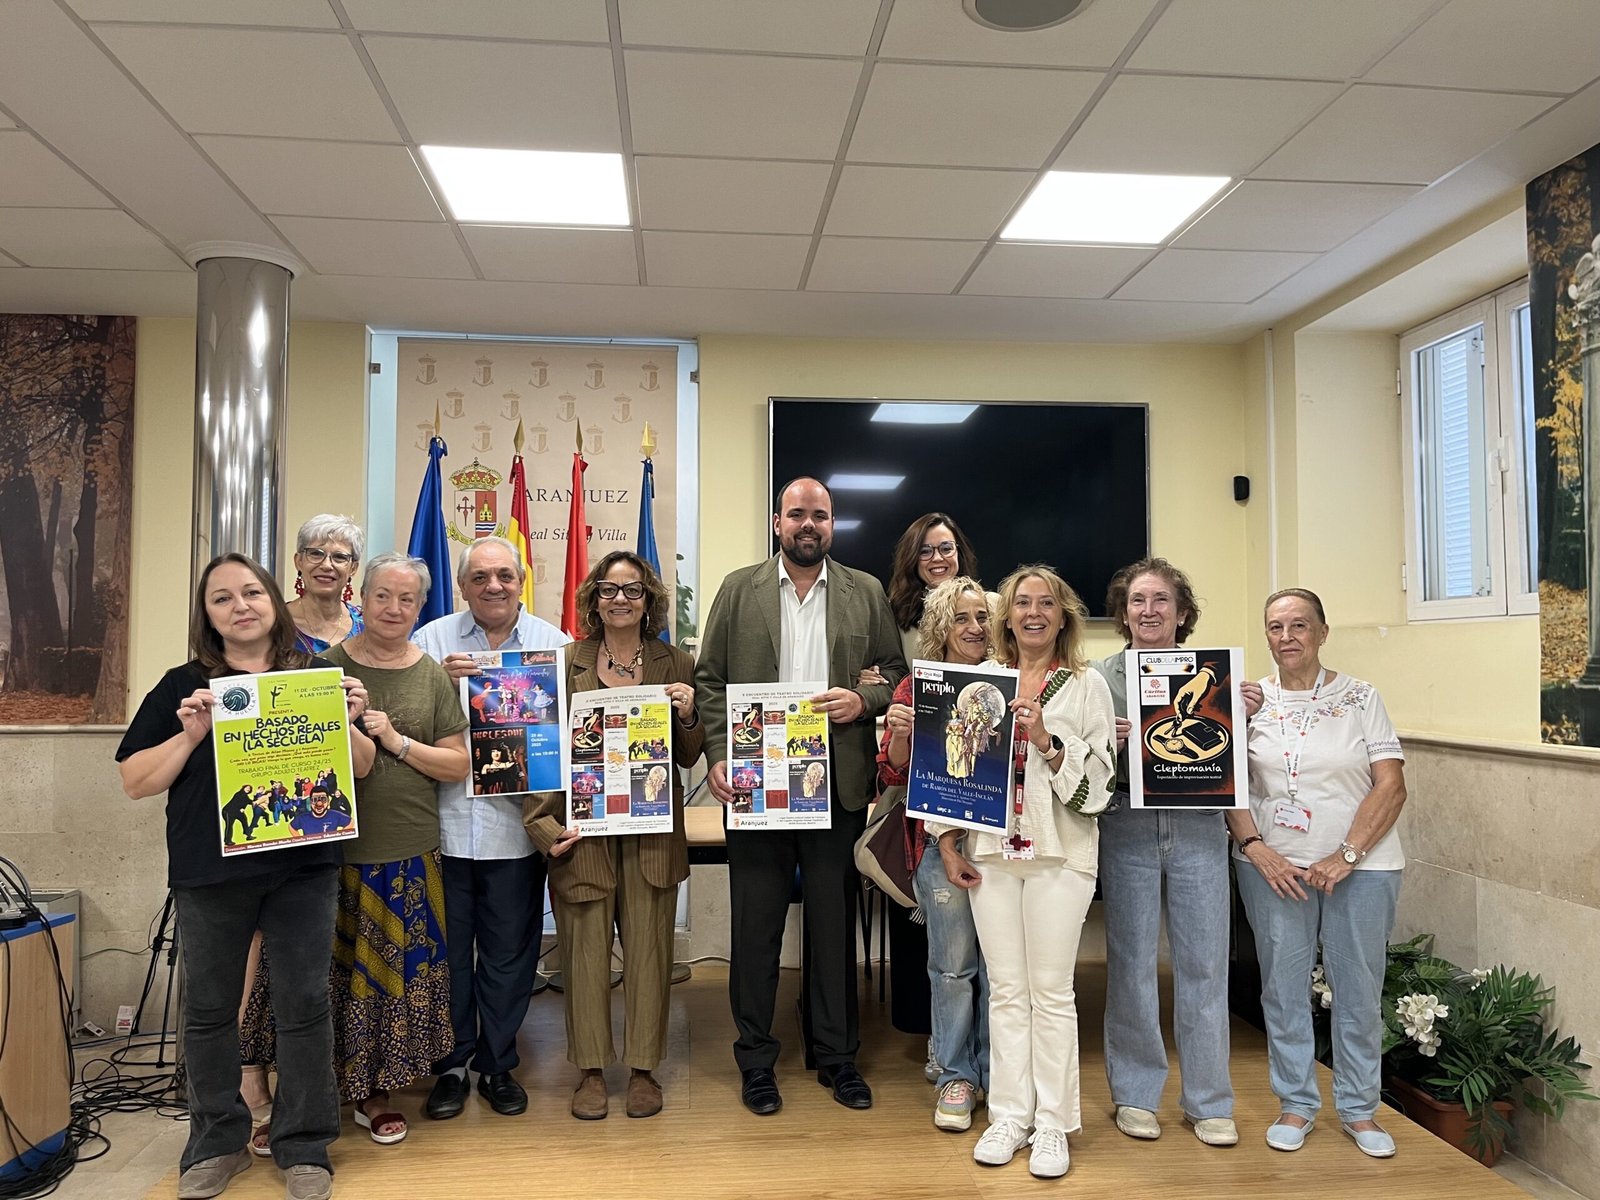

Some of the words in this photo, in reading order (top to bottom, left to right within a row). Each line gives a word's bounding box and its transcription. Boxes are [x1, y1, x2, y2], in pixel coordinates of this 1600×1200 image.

[531, 528, 547, 540] eal
[598, 529, 626, 541] Villa
[256, 715, 308, 728] BASADO
[224, 732, 240, 742] EN
[244, 727, 294, 740] HECHOS
[297, 721, 341, 734] REALES
[243, 738, 264, 752] (LA
[268, 732, 324, 748] SECUELA)
[239, 766, 264, 774] TRABAJO
[1154, 763, 1222, 776] Cleptomanía
[916, 769, 925, 779] LA
[927, 771, 961, 786] MARQUESA
[963, 778, 1002, 794] ROSALINDA
